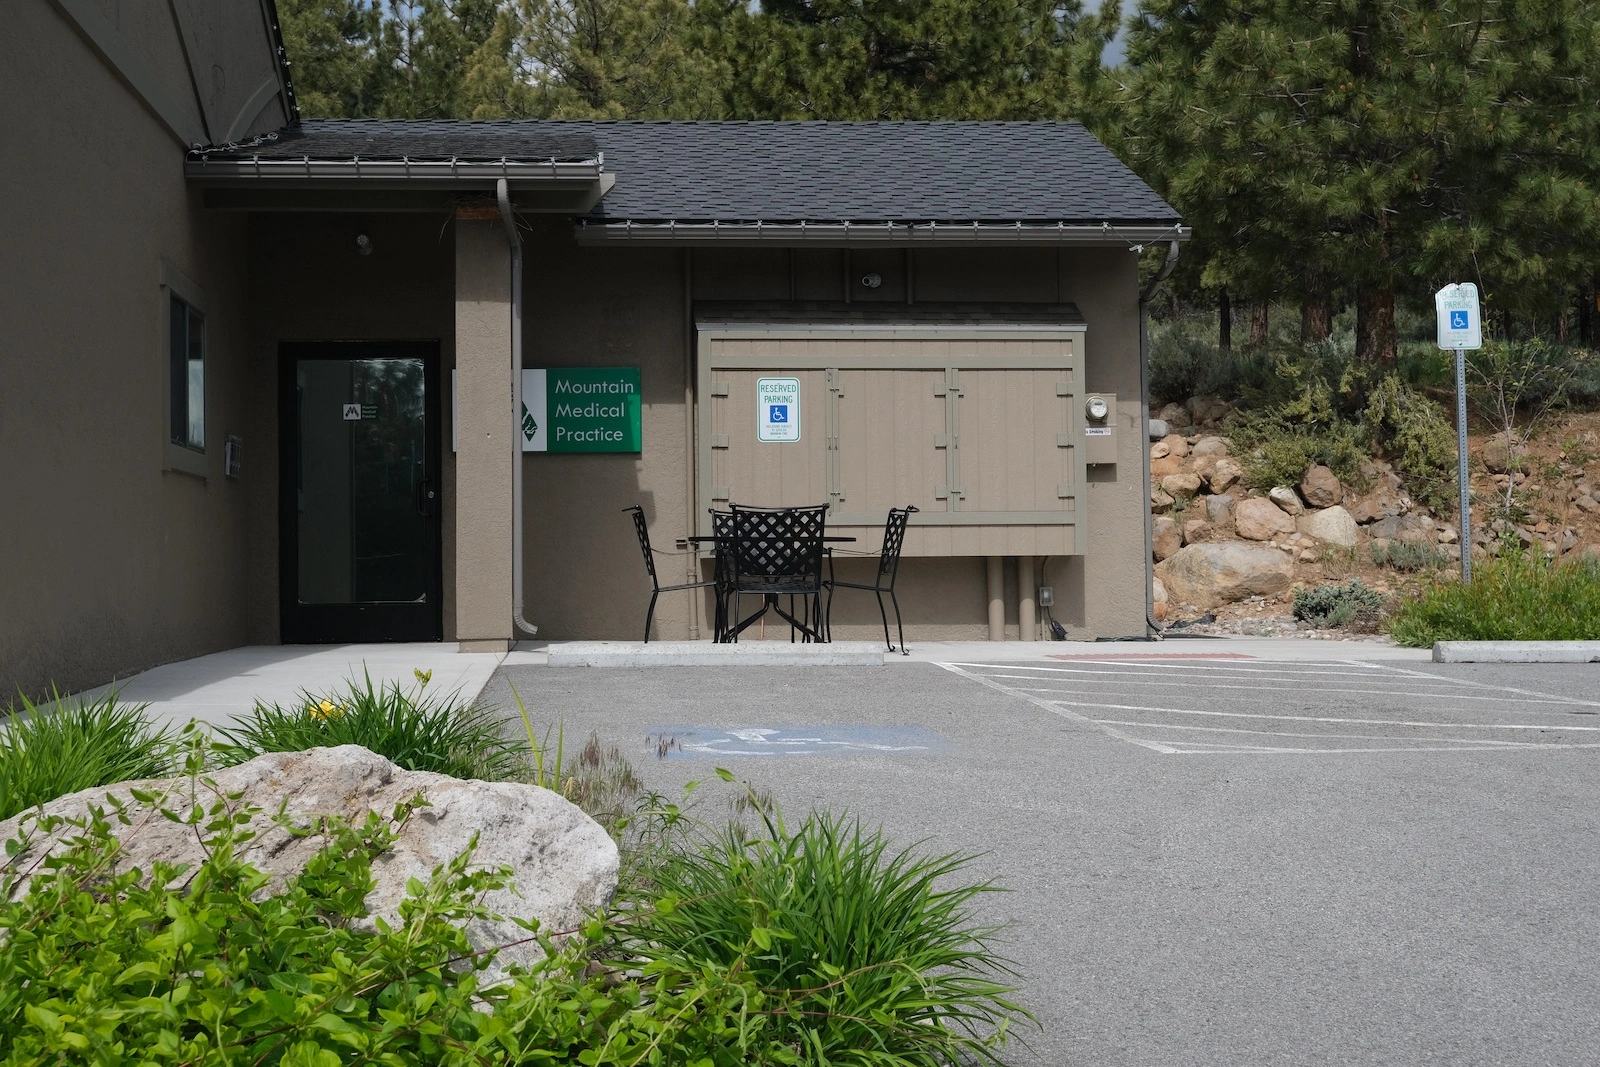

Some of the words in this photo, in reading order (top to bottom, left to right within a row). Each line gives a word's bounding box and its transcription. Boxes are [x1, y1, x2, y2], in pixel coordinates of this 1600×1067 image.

[1444, 301, 1472, 309] PARKING
[555, 379, 634, 394] Mountain
[760, 384, 797, 393] RESERVED
[764, 395, 793, 403] PARKING
[555, 402, 625, 417] Medical
[556, 426, 624, 441] Practice
